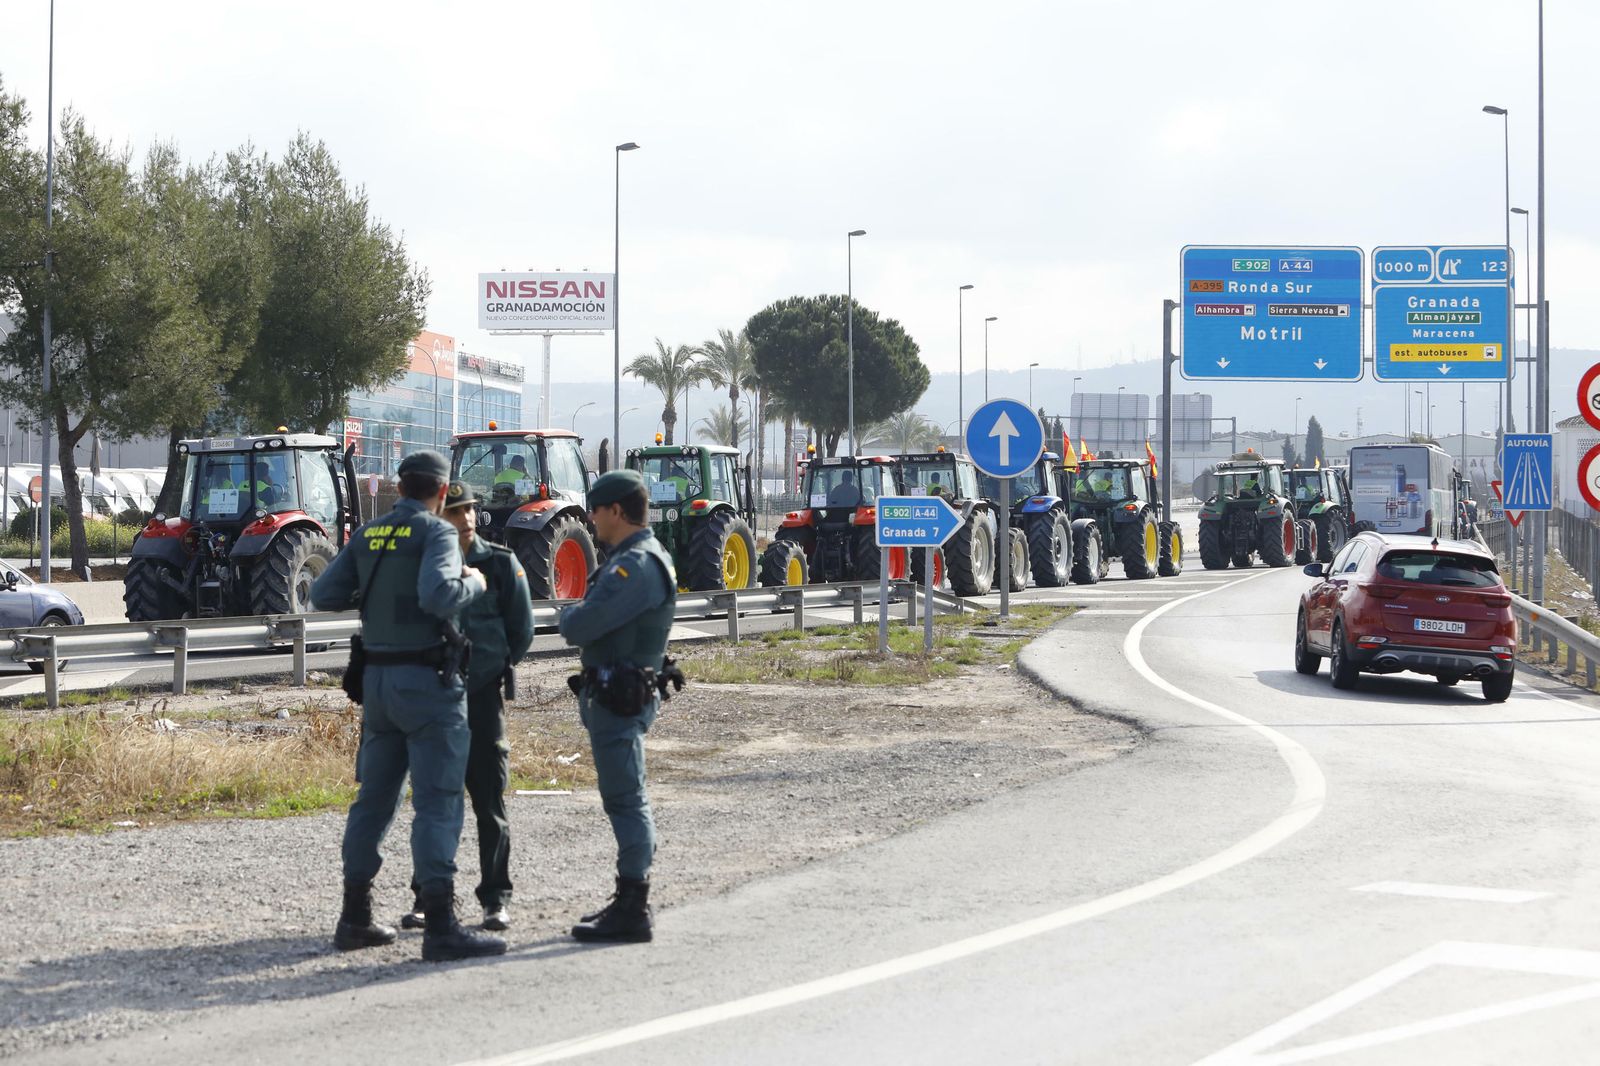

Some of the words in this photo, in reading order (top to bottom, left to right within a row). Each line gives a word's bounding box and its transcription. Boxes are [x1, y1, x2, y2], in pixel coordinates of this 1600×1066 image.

[1234, 261, 1268, 270] E-902
[1281, 261, 1311, 270] A-44
[1378, 262, 1414, 273] 1000
[1417, 263, 1428, 272] m
[1482, 261, 1508, 272] 123
[486, 281, 605, 299] NISSAN
[1192, 281, 1223, 290] A-395
[1228, 281, 1279, 293] Ronda
[1285, 281, 1313, 293] Sur
[486, 300, 605, 313] GRANADAMOCIÓN
[1407, 295, 1480, 308] Granada
[1196, 305, 1240, 314] Alhambra
[1270, 306, 1298, 314] Sierra
[1301, 306, 1334, 314] Nevada
[1240, 325, 1302, 341] Motril
[1412, 328, 1475, 338] Maracena
[1395, 348, 1414, 357] est.
[1417, 348, 1468, 357] autobuses
[1507, 438, 1549, 448] AUTOVÍA
[884, 508, 910, 517] E-902
[915, 508, 936, 517] A-44
[882, 526, 926, 538] Granada
[933, 527, 939, 538] 7
[1420, 620, 1443, 631] 9802
[1446, 622, 1463, 632] LDH
